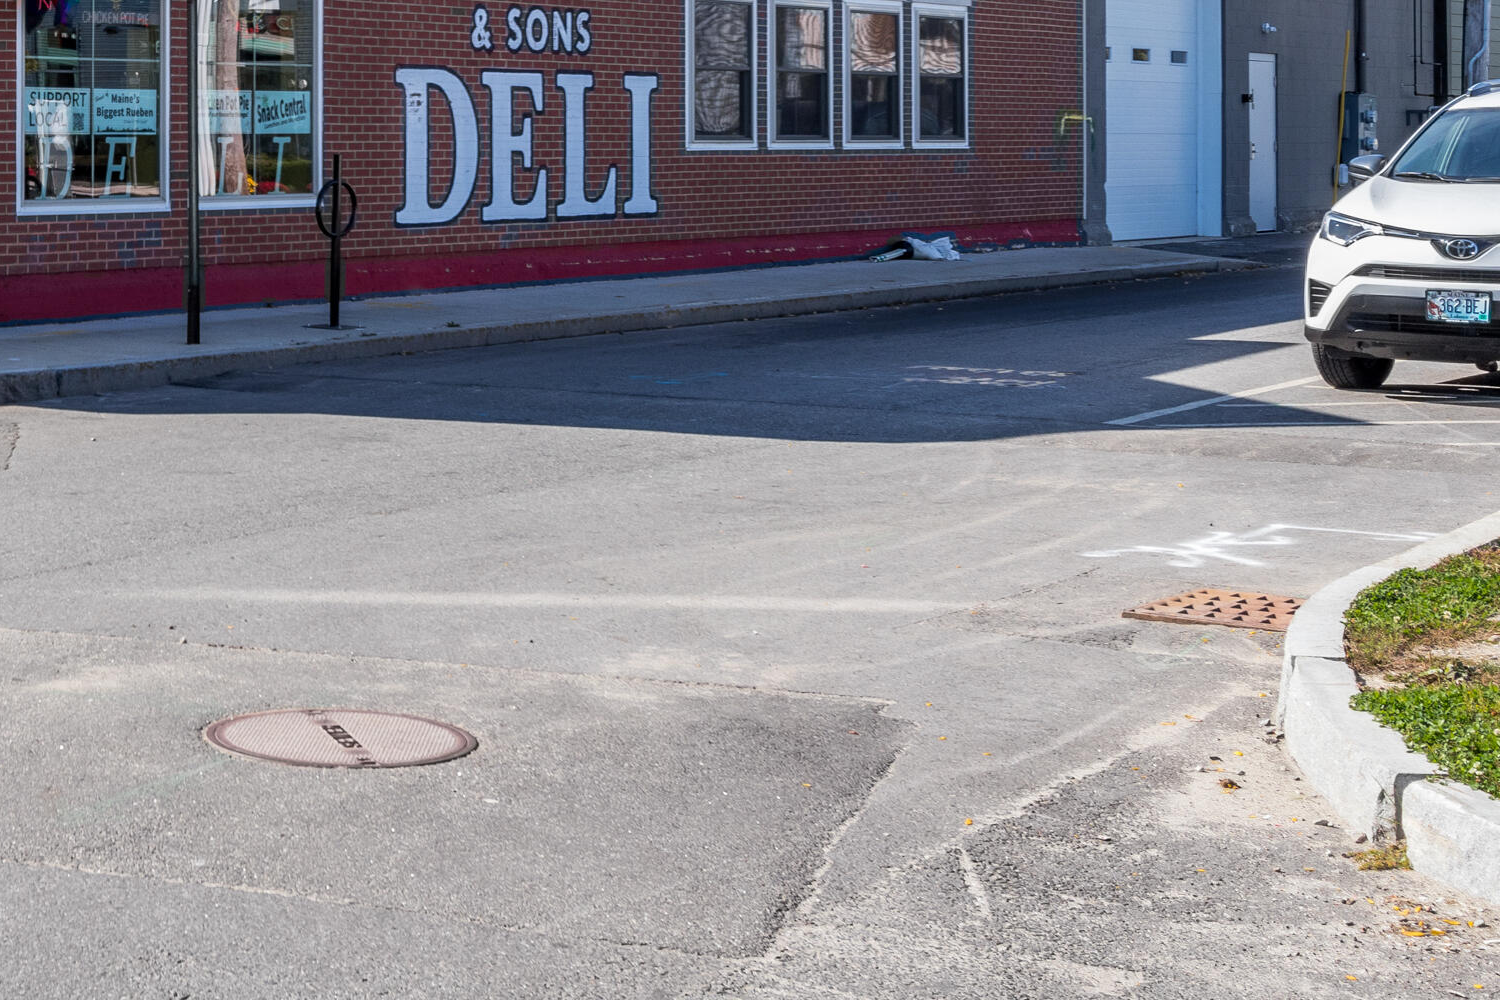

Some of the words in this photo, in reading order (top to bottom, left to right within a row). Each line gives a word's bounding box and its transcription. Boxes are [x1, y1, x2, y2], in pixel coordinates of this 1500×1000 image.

[471, 7, 493, 50] &
[507, 6, 592, 52] SONS
[29, 91, 87, 107] SUPPORT
[111, 93, 140, 104] Maine's
[239, 94, 250, 111] Pie
[96, 107, 125, 119] Biggest
[126, 107, 153, 117] Rueben
[257, 100, 279, 123] Snack
[280, 93, 306, 118] Central
[29, 111, 67, 127] LOCAL
[395, 67, 659, 224] DELI
